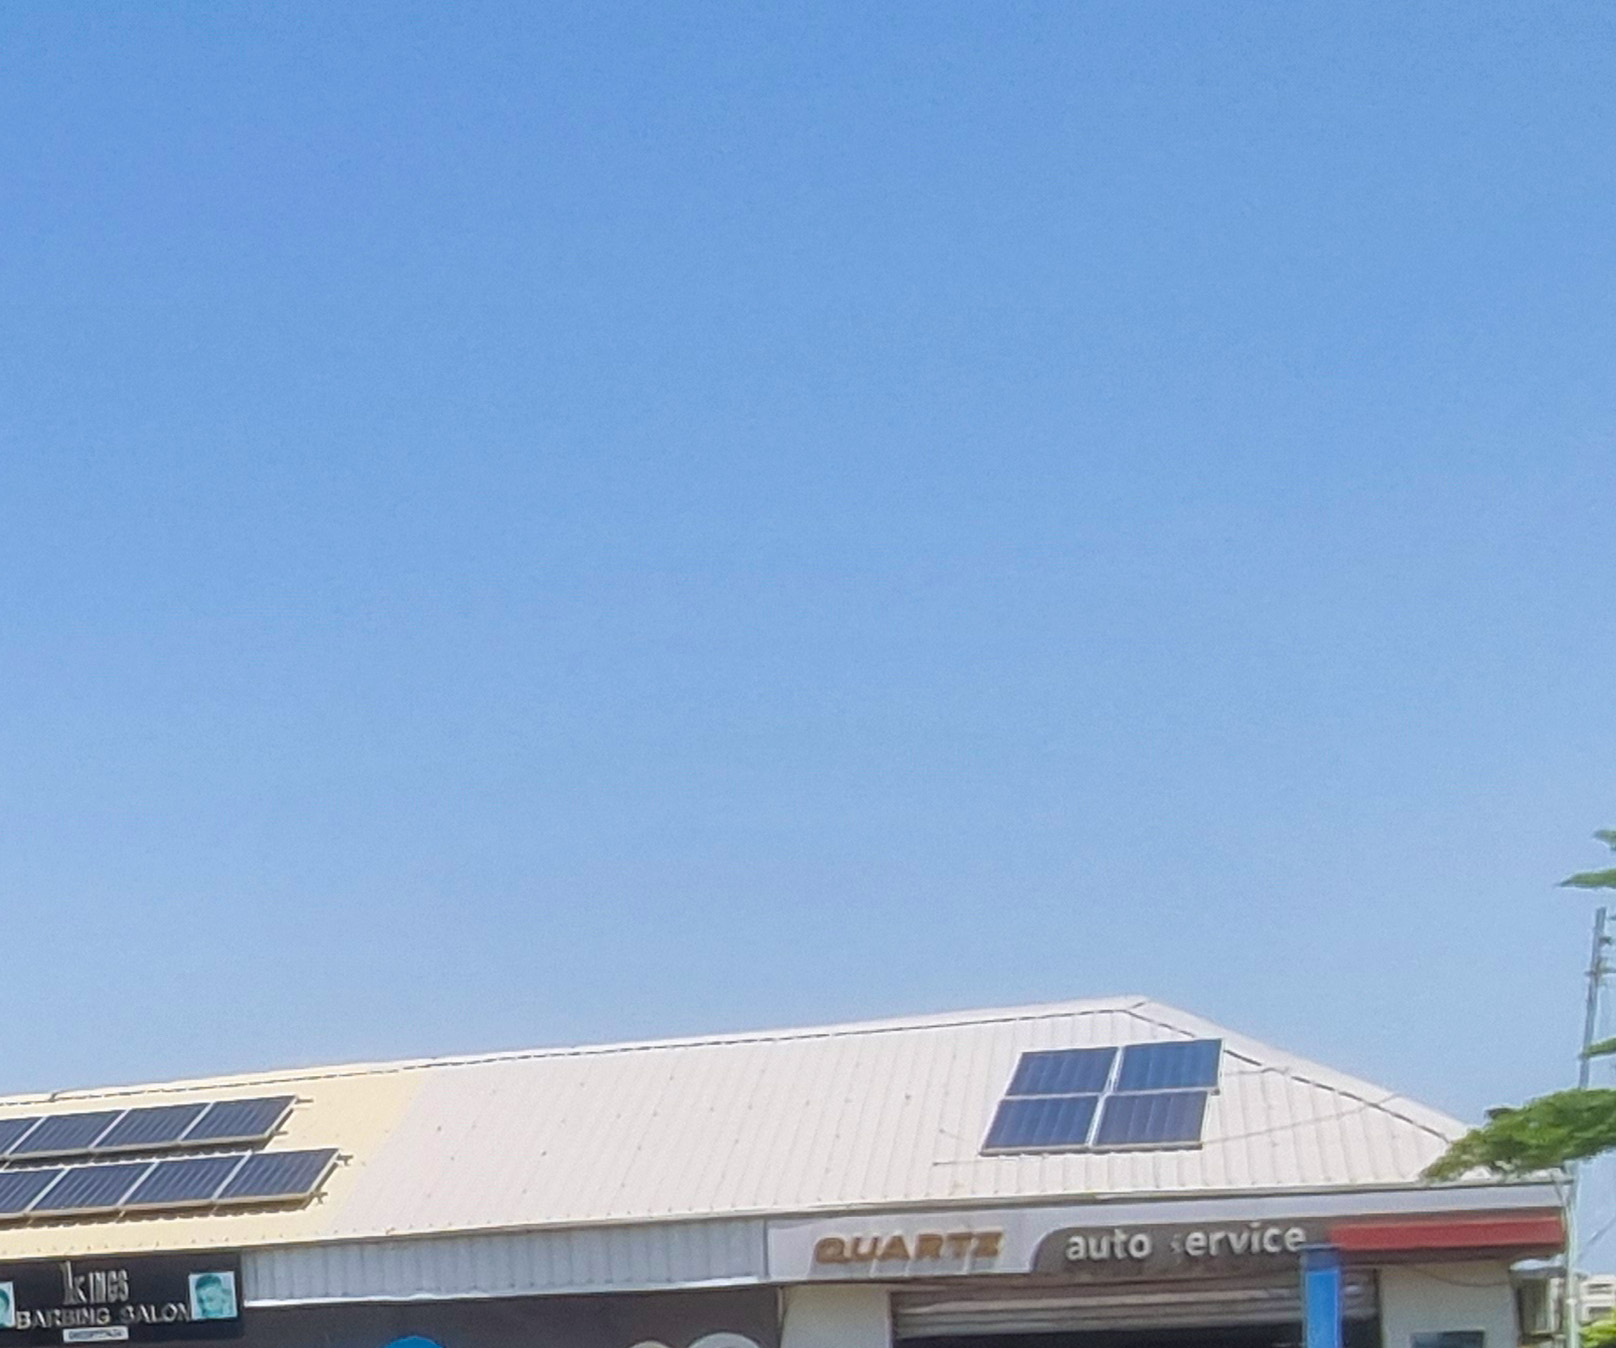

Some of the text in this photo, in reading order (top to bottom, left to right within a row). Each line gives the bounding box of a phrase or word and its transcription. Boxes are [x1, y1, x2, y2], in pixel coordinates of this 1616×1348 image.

[815, 1230, 1003, 1264] QUARTZ
[1066, 1229, 1151, 1261] auto
[15, 1302, 193, 1330] BARBING SALON
